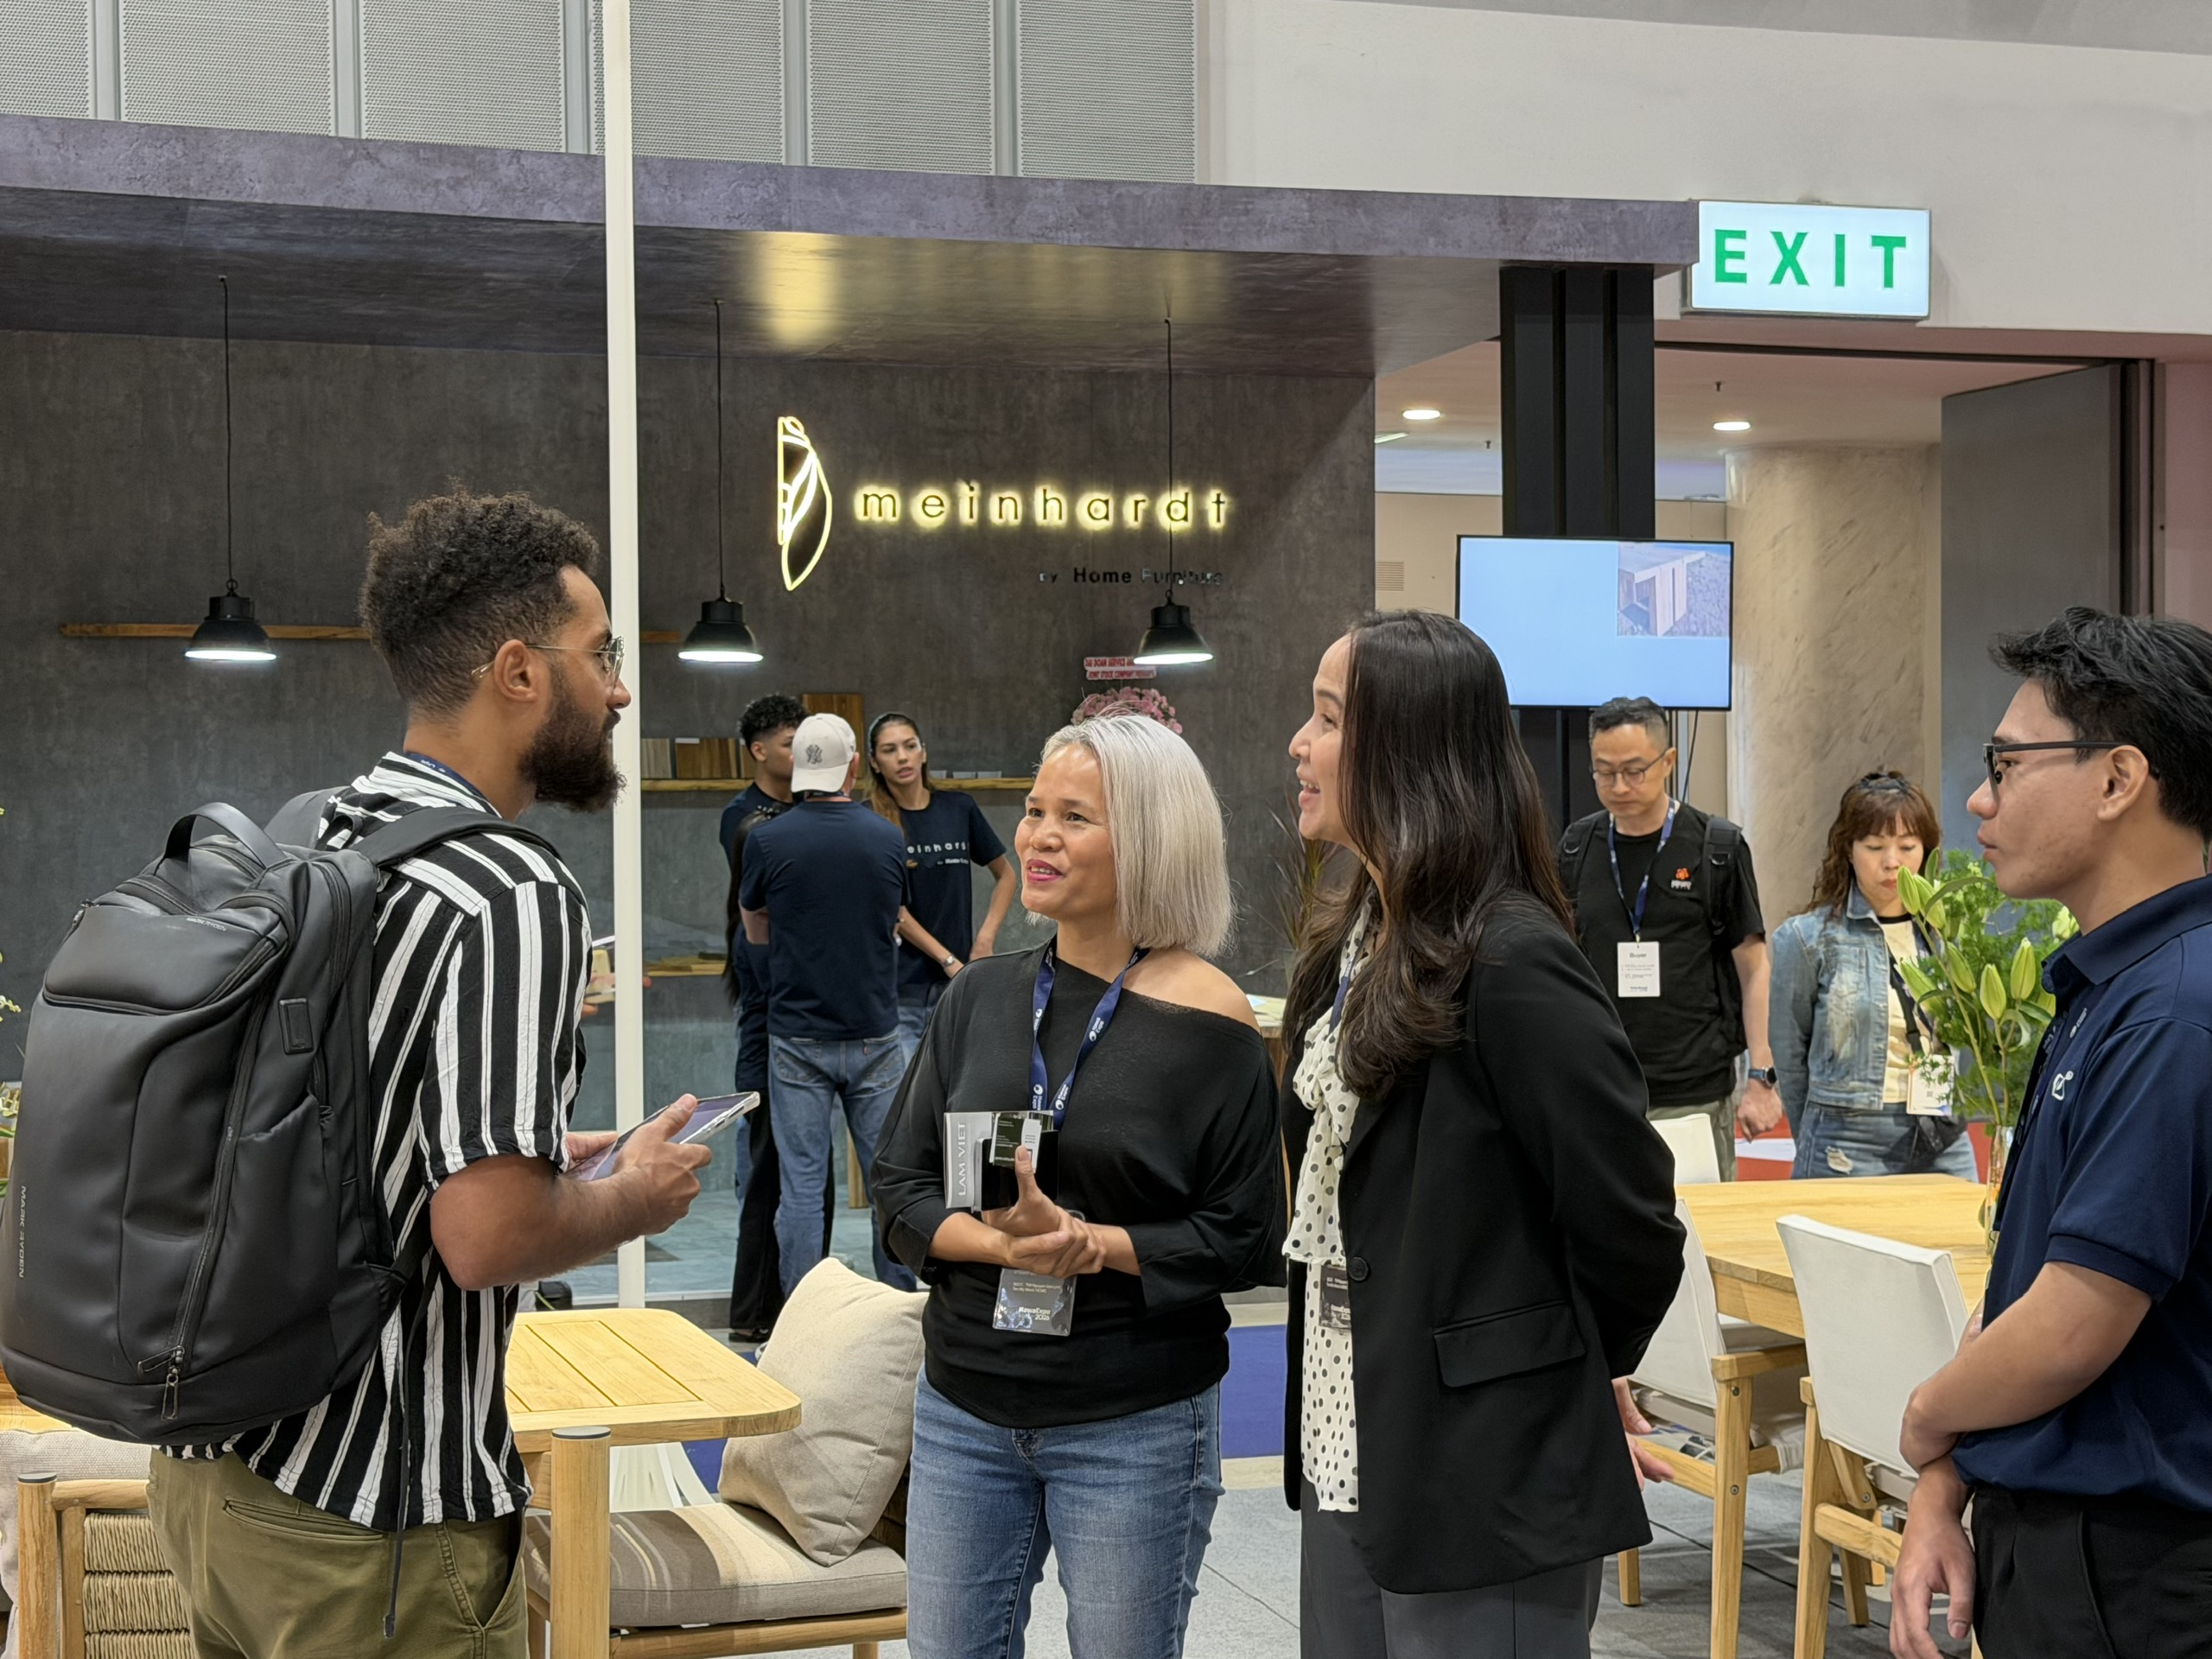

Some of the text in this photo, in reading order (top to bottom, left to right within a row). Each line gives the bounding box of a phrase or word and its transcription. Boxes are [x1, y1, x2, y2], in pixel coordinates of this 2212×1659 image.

[1714, 229, 1907, 289] EXIT
[861, 484, 1227, 524] meinhardt
[1073, 567, 1132, 584] Home
